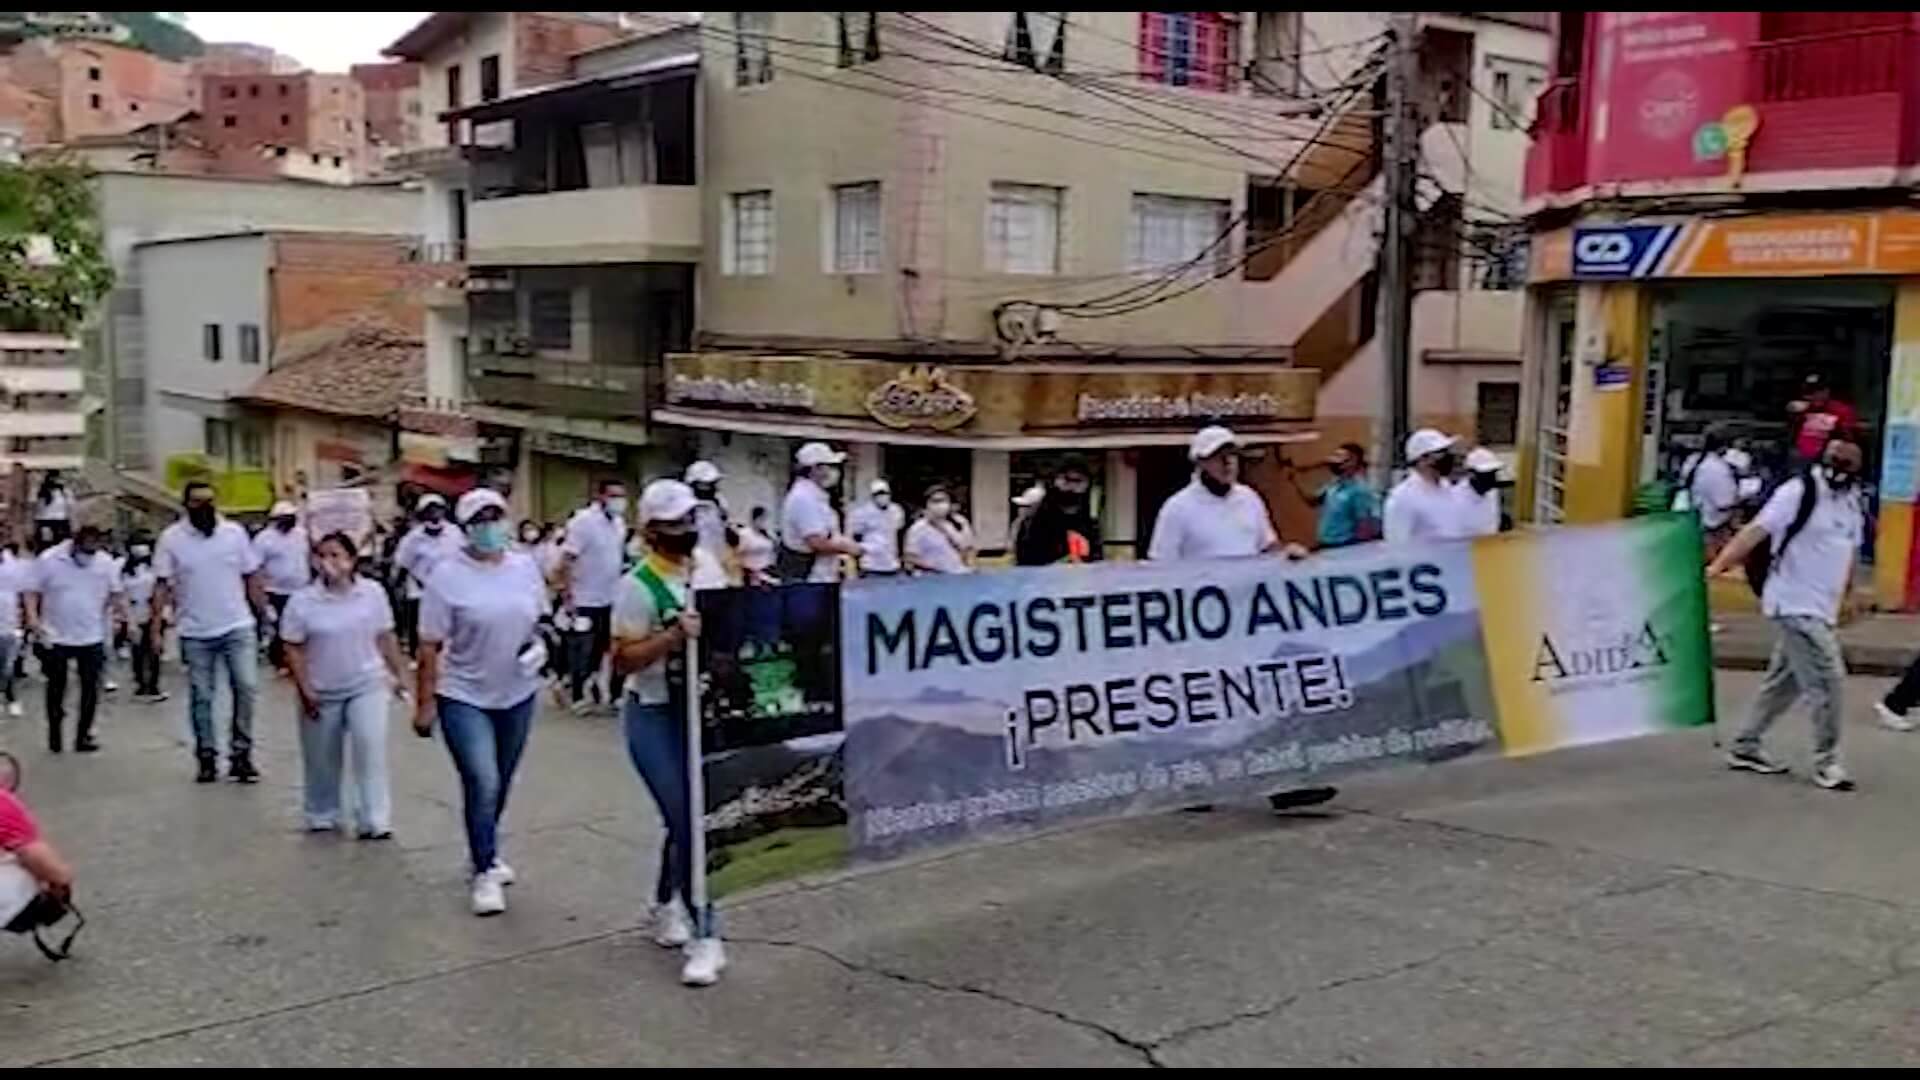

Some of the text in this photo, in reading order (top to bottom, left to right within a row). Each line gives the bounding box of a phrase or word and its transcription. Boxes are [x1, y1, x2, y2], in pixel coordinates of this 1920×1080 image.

[866, 564, 1447, 675] MAGISTERIO ANDES
[1006, 654, 1352, 768] ¡PRESENTE!
